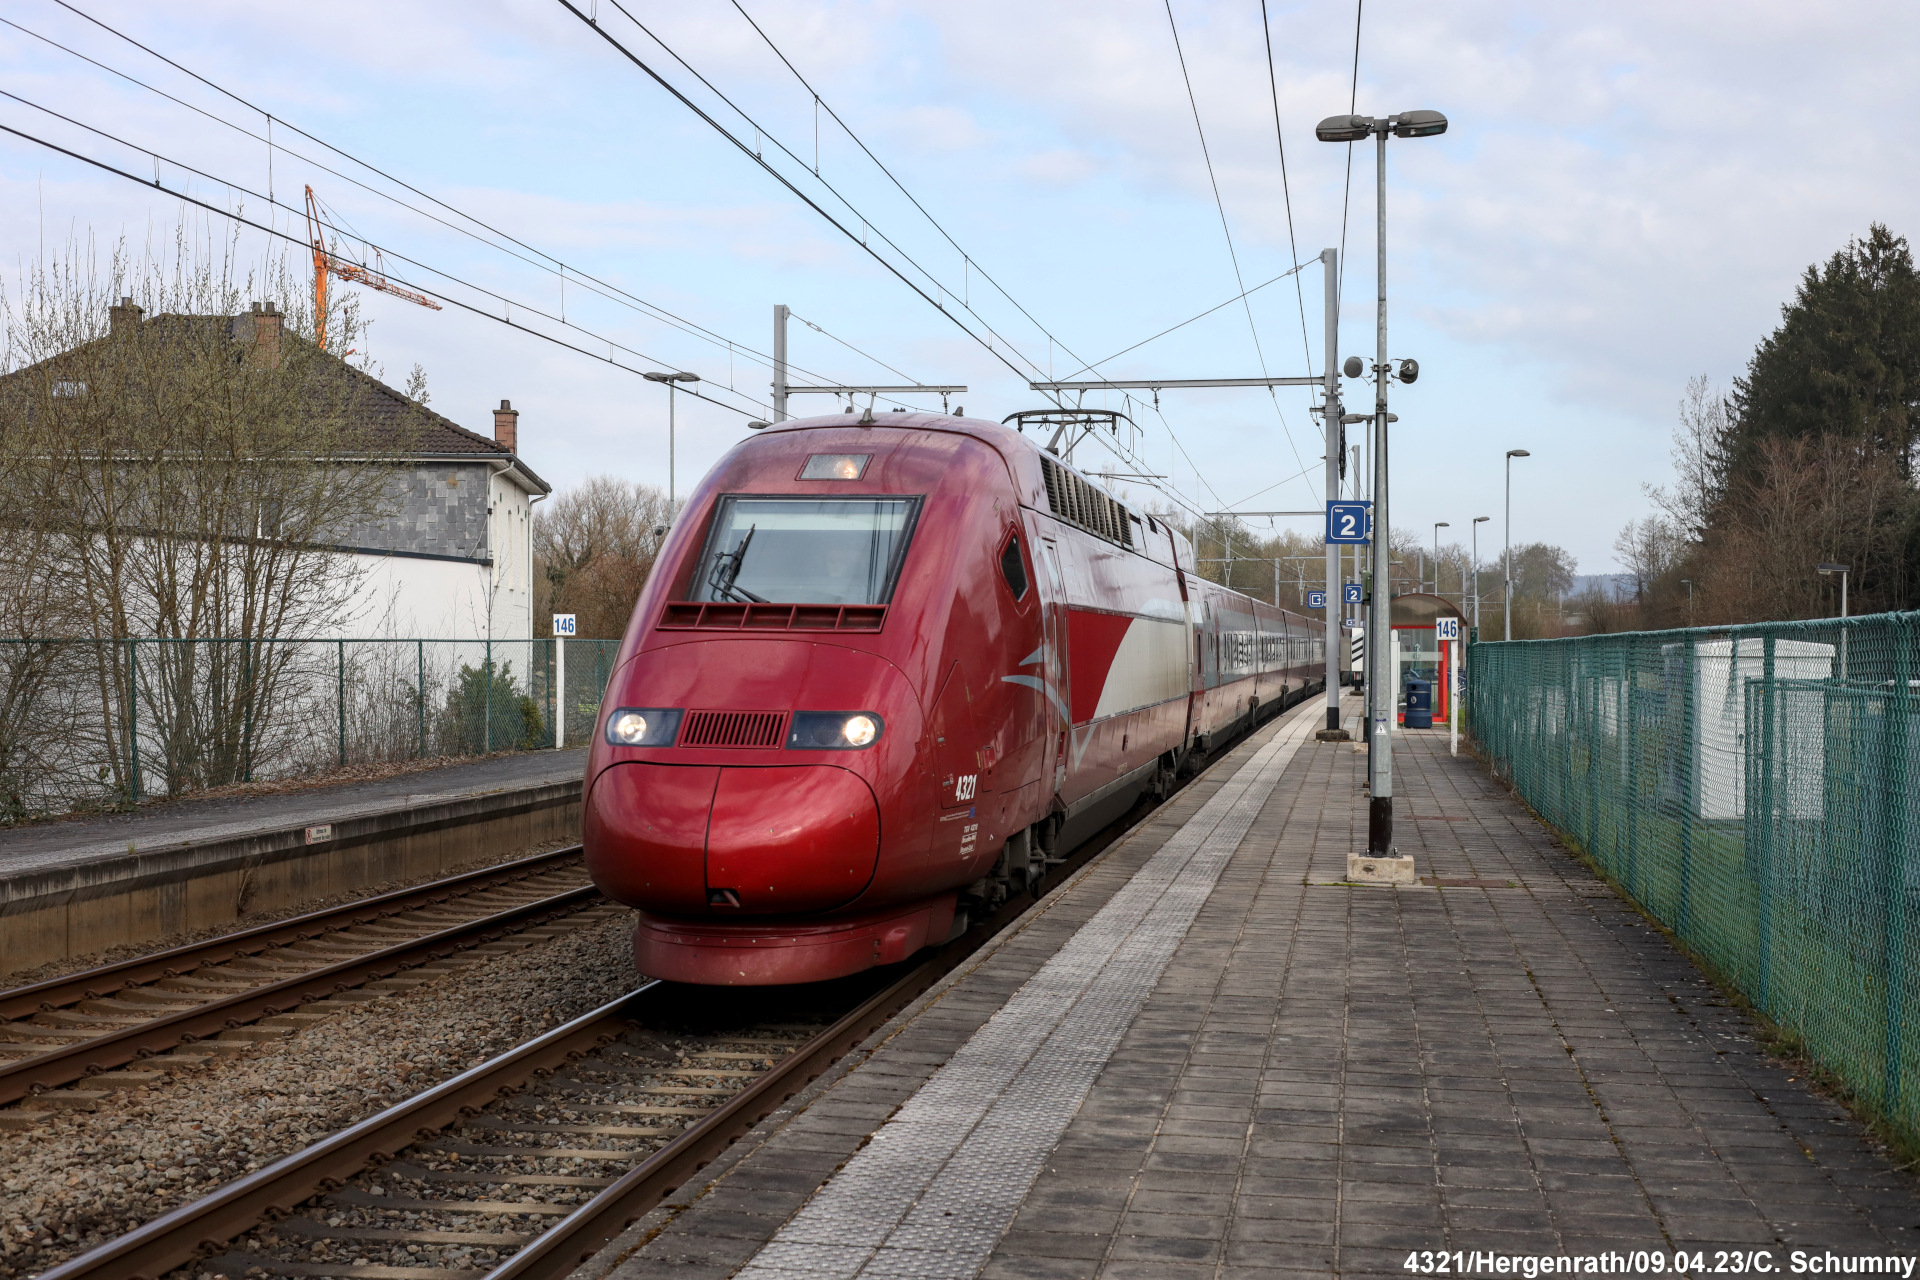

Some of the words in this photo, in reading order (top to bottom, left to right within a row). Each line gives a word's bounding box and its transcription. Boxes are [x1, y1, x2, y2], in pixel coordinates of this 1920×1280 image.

[1340, 514, 1356, 536] 2
[1350, 590, 1358, 600] 2
[555, 617, 575, 633] 146
[1437, 620, 1457, 638] 146
[955, 774, 977, 801] 4321
